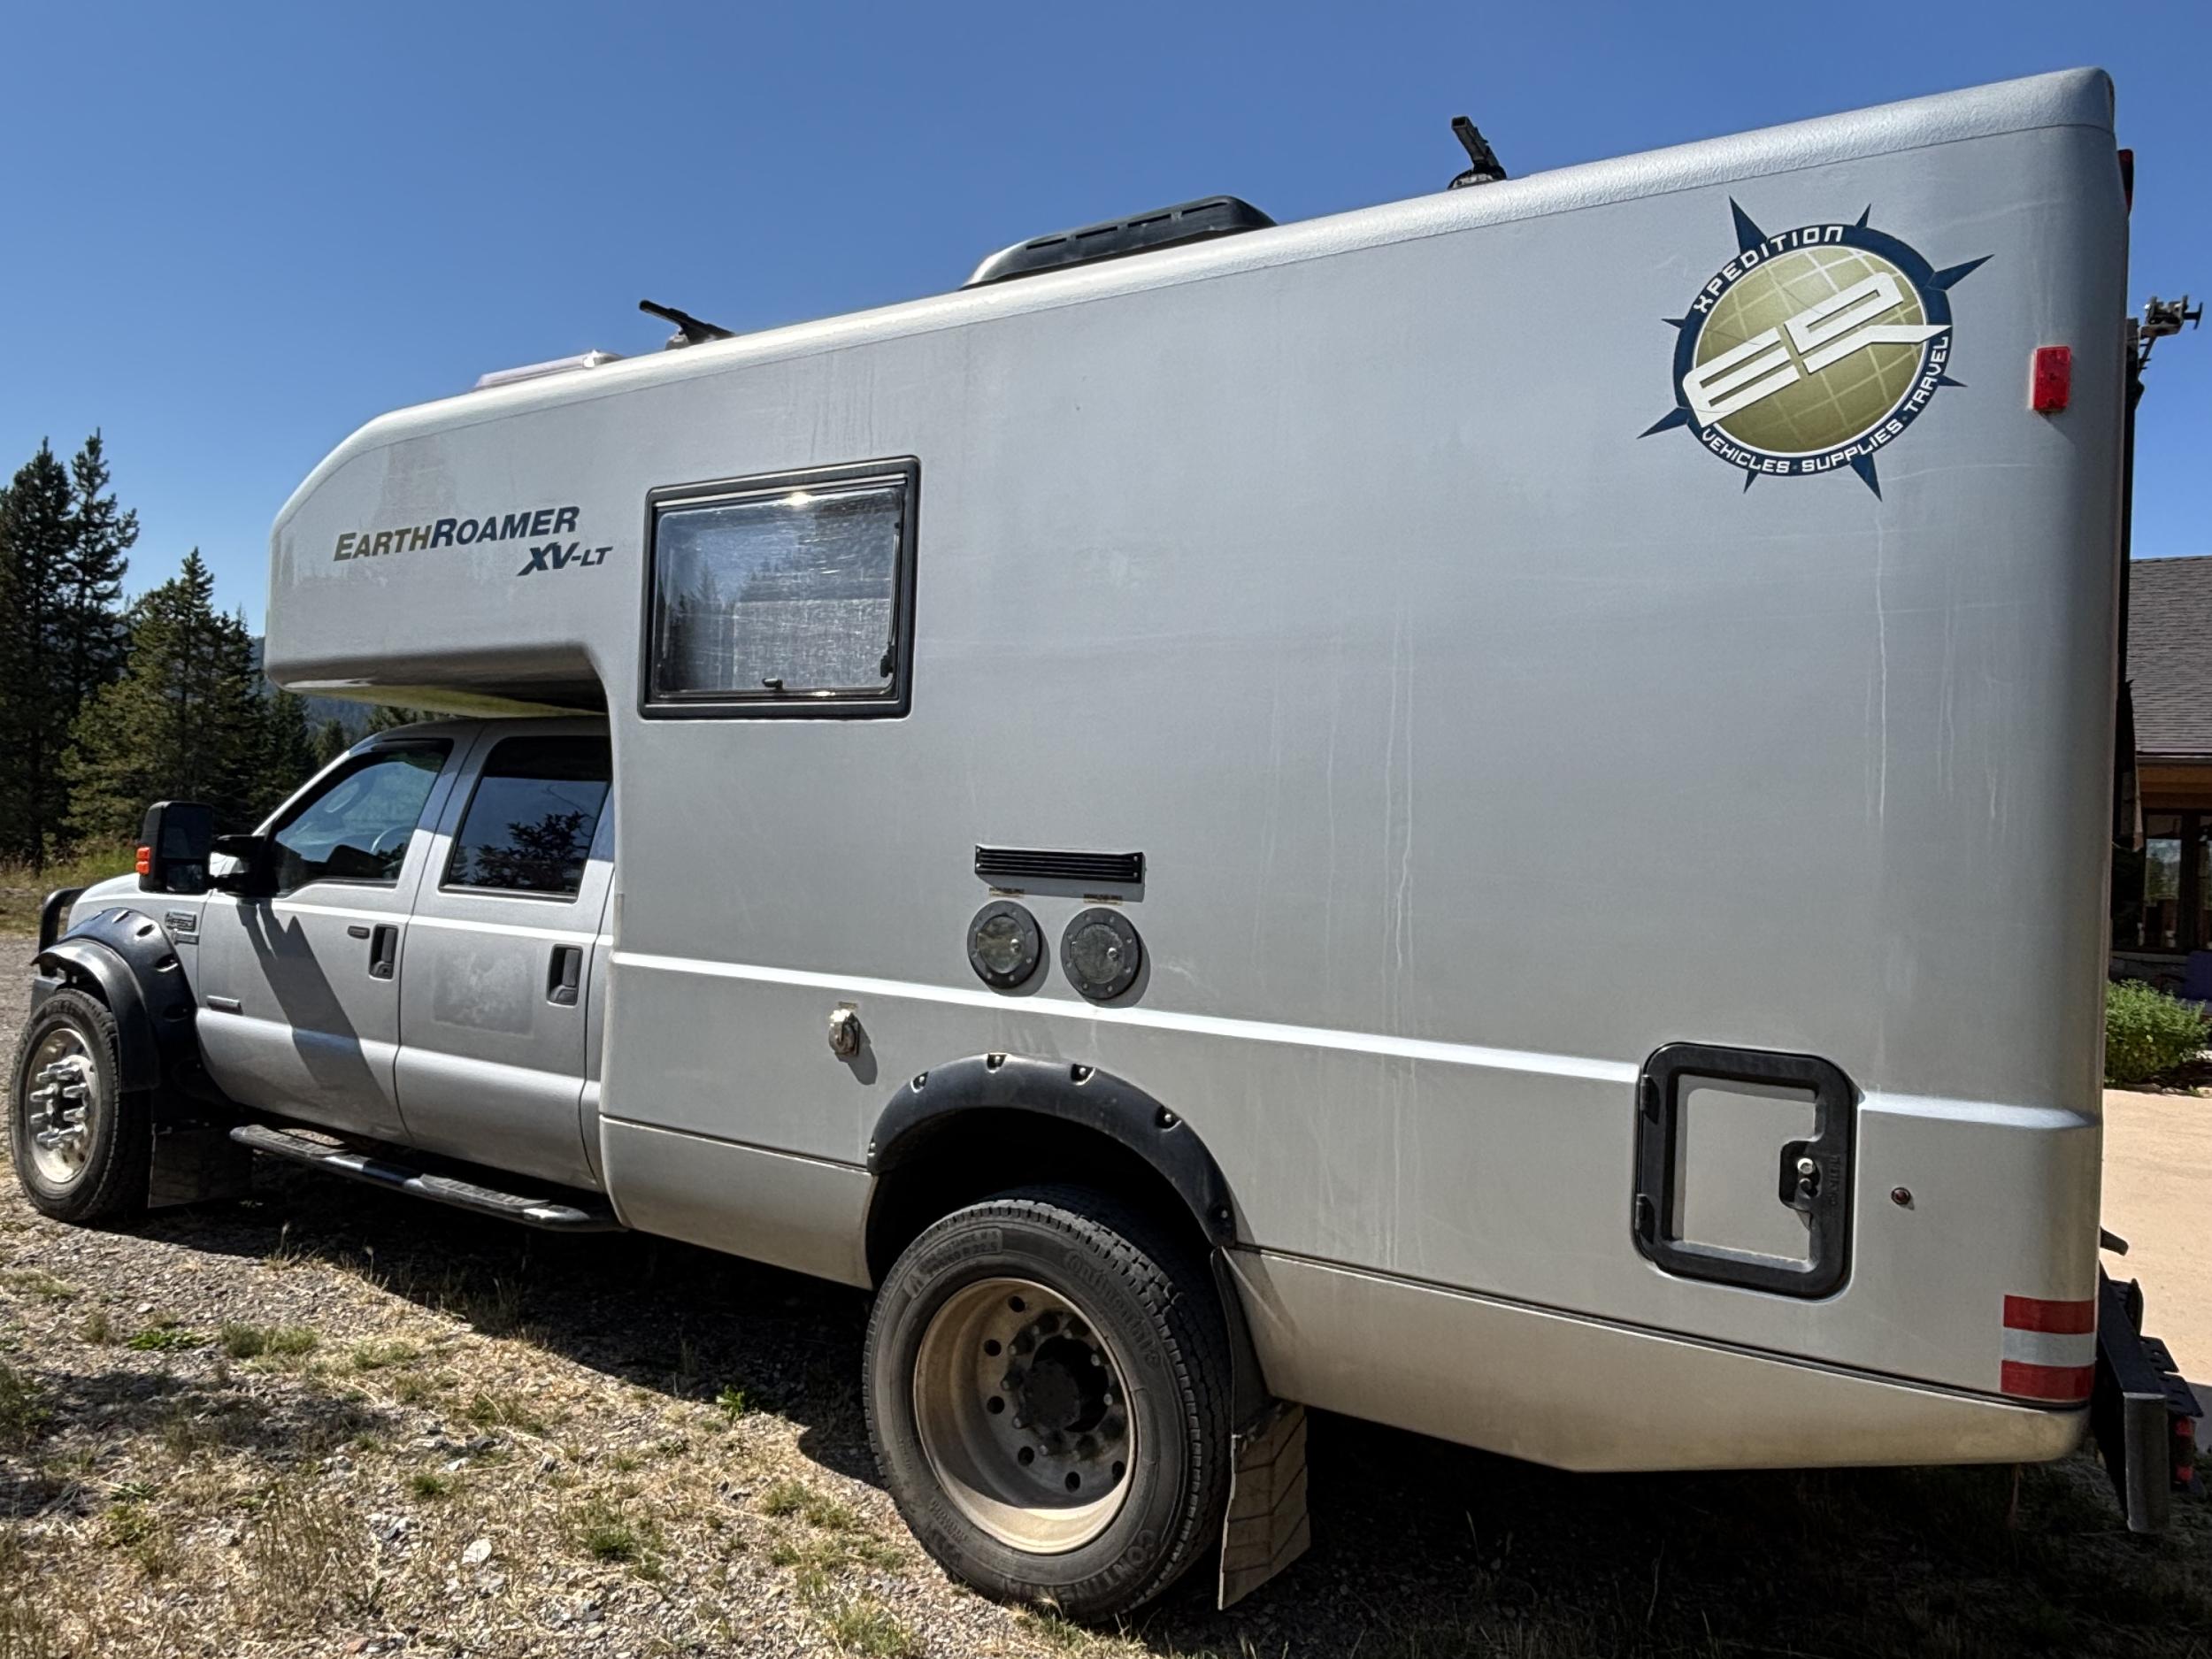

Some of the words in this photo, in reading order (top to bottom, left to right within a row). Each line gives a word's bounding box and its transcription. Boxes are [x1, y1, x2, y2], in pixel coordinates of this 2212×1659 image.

[1694, 226, 1843, 313] XPEDITION
[1701, 428, 1791, 473] VEHICLES
[1801, 419, 1903, 472] SUPPLIES
[1903, 336, 1948, 412] TRAVEL
[517, 541, 613, 576] XV-LT
